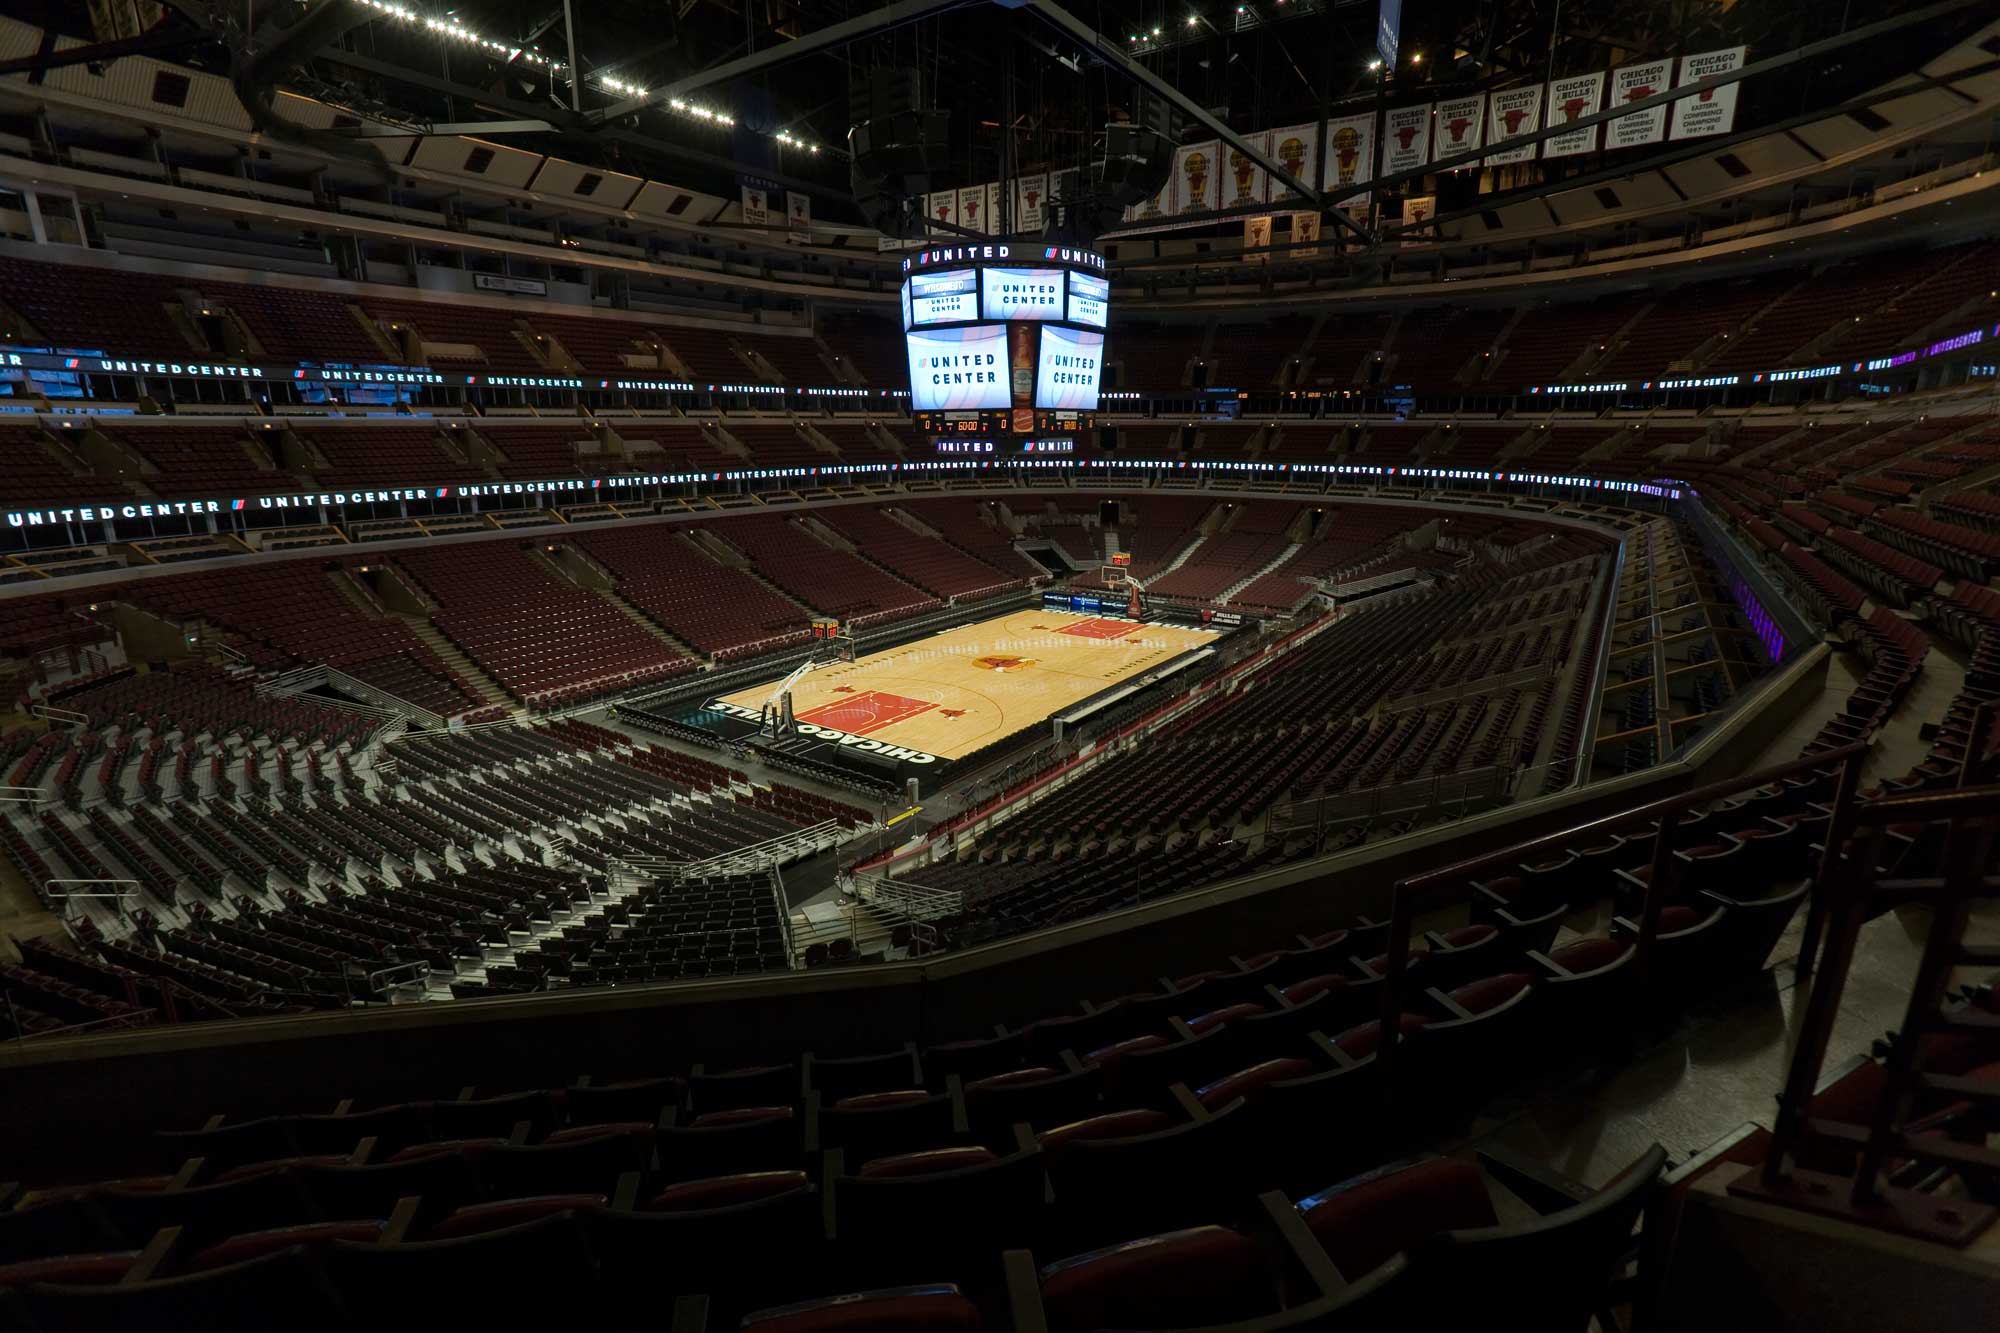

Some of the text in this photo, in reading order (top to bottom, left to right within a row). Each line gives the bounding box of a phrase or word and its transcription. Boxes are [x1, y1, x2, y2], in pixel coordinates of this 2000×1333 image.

[1689, 53, 1737, 68] CHICAGO
[1619, 65, 1664, 81] CHICAGO
[1694, 63, 1728, 76] BULLS
[1555, 78, 1597, 93] CHICAGO
[1625, 74, 1657, 88] BULLS
[1496, 90, 1535, 104] CHICAGO
[1561, 87, 1591, 100] BULLS
[1442, 100, 1478, 113] CHICAGO
[1502, 99, 1528, 111] BULLS
[1447, 108, 1473, 120] BULLS
[932, 246, 1010, 262] UNITED
[1003, 284, 1055, 293] UNITED
[931, 297, 961, 305] UNITED
[1003, 296, 1055, 304] CENTER
[931, 304, 961, 313] CENTER
[931, 354, 995, 368] UNITED
[1055, 354, 1095, 370] UNITED
[932, 371, 996, 385] CENTER
[1053, 371, 1093, 386] CENTER
[798, 724, 936, 764] CHICAGO
